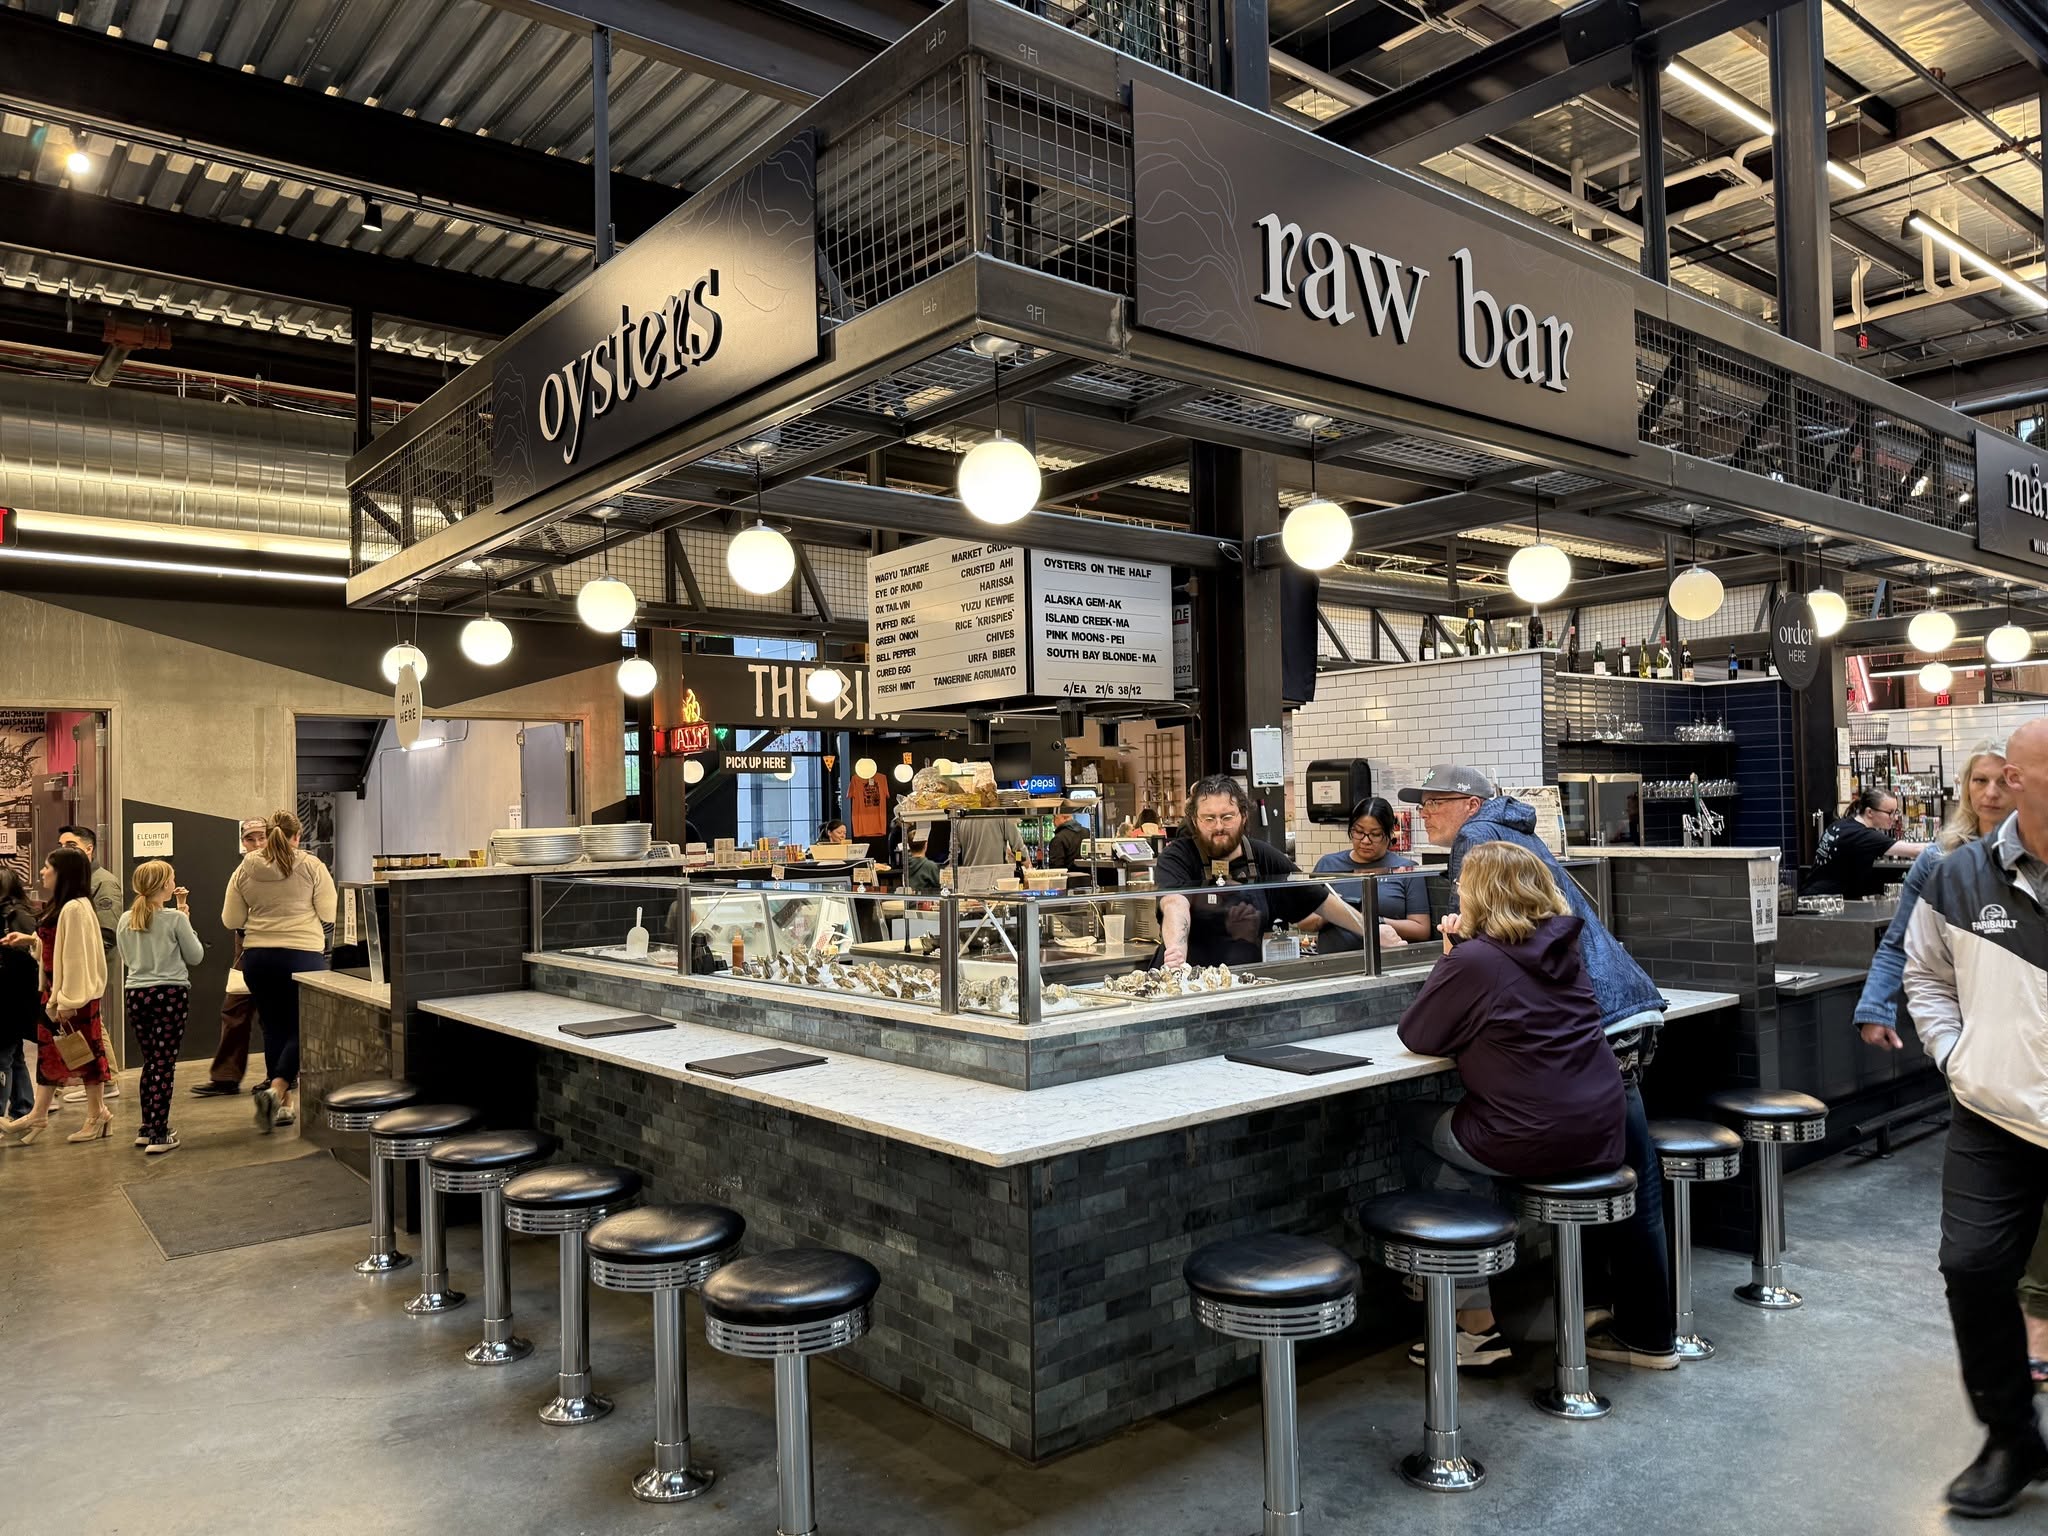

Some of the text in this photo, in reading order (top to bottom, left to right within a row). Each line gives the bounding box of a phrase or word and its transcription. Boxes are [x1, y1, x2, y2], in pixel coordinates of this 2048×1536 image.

[1256, 212, 1574, 392] raw bar
[539, 268, 722, 464] oysters
[952, 547, 983, 563] MARKET
[875, 563, 929, 583] WAGYU TARTARE
[961, 557, 1014, 578] CRUSTED AHI
[1044, 557, 1152, 579] OYSTERS ON THE HALF
[875, 581, 923, 599] EYE OF ROUND
[979, 576, 1014, 592] HARISSA
[961, 593, 1015, 613] YUZU KEWPIE
[1044, 594, 1083, 606] ALASKA
[875, 604, 885, 614] OX
[876, 614, 916, 632] PUFFED RICE
[955, 619, 973, 631] RICE
[1045, 613, 1079, 624] ISLAND
[875, 630, 919, 646] GREEN ONION
[986, 629, 1015, 643] CHIVES
[1046, 629, 1068, 640] PINK
[1779, 620, 1814, 646] order
[876, 647, 917, 663] BELL PEPPER
[967, 647, 1016, 664] URFA BIBER
[1046, 647, 1079, 659] SOUTH
[1082, 650, 1101, 661] BAY
[1788, 650, 1807, 663] HERE
[876, 664, 912, 678] CURED EGG
[933, 665, 1017, 687] TANGERINE AGRUMATO
[877, 680, 916, 694] FRESH MINT
[1062, 681, 1142, 699] 4/EA 21/6 38/12
[401, 691, 414, 706] PAY
[1936, 694, 1950, 706] EXIT
[399, 708, 417, 724] HERE
[725, 756, 786, 769] PICK UP HERE
[1030, 777, 1057, 790] pepsi
[1971, 919, 2018, 932] FARIBAULT
